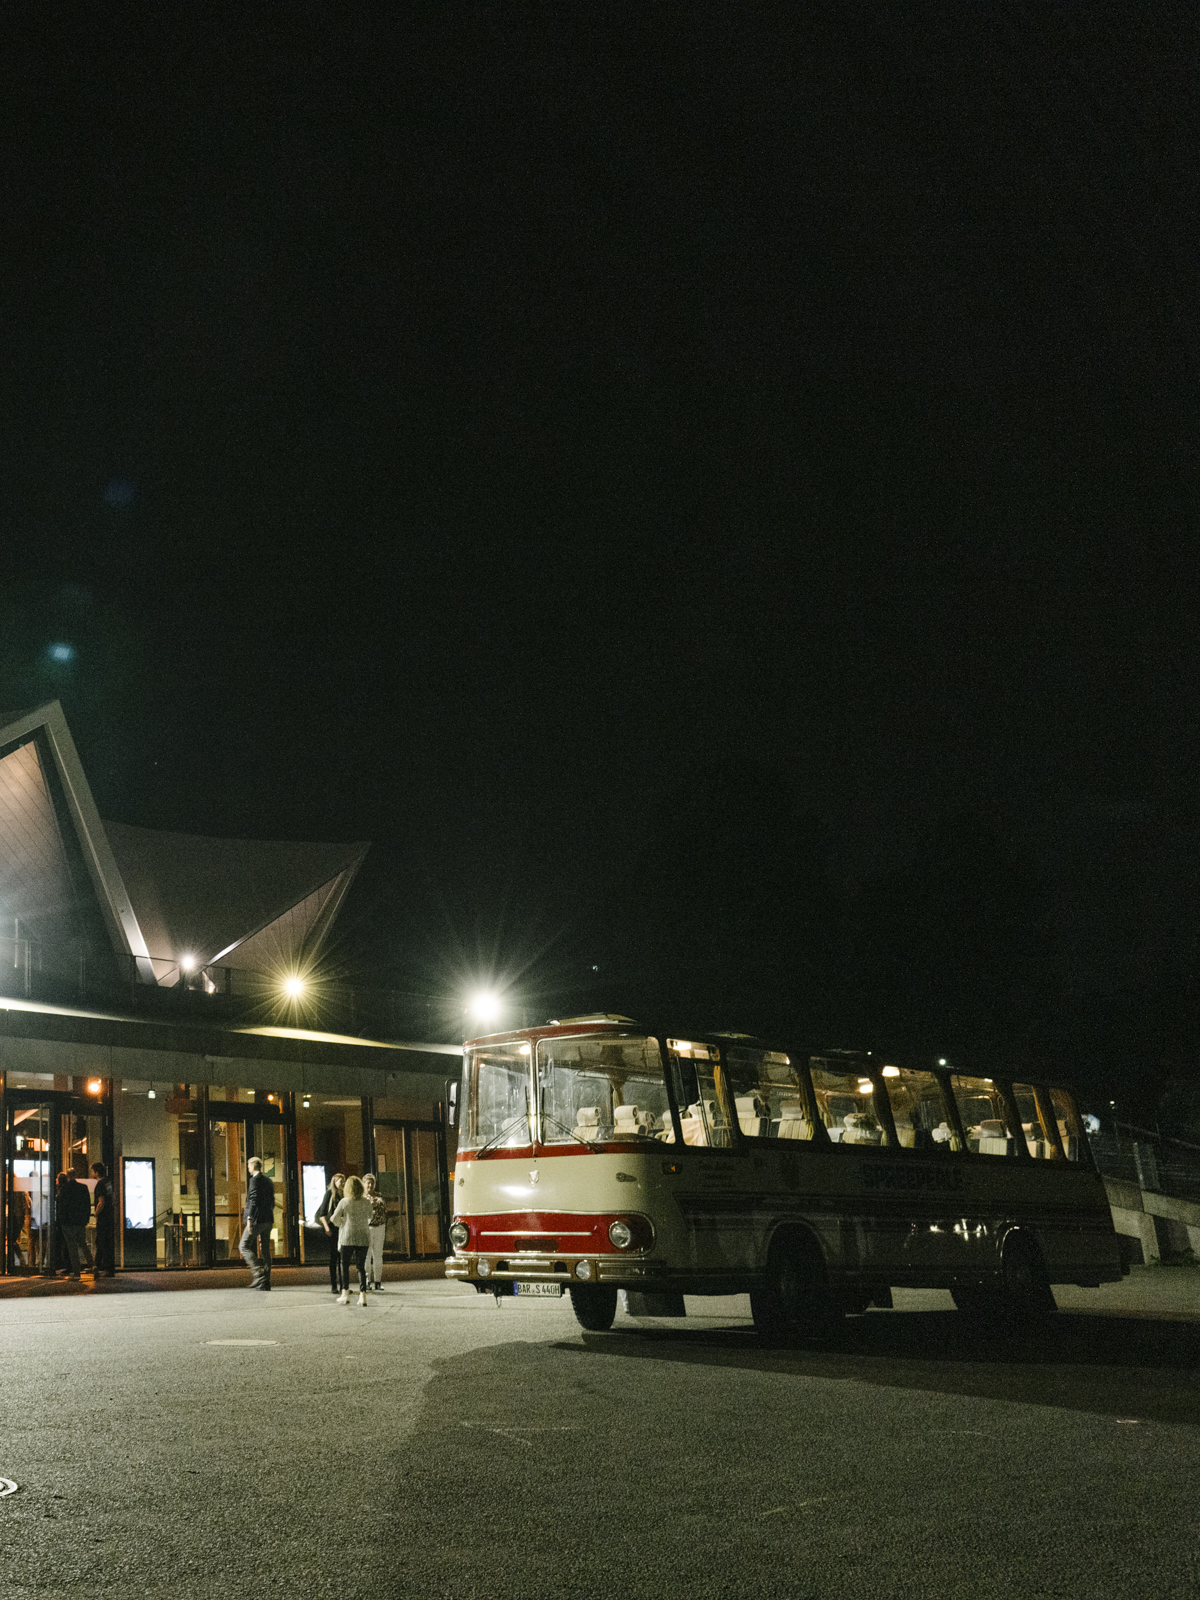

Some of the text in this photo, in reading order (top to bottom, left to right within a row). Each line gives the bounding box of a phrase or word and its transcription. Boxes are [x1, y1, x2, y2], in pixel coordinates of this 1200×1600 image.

[518, 1284, 560, 1295] BAR S 440H
